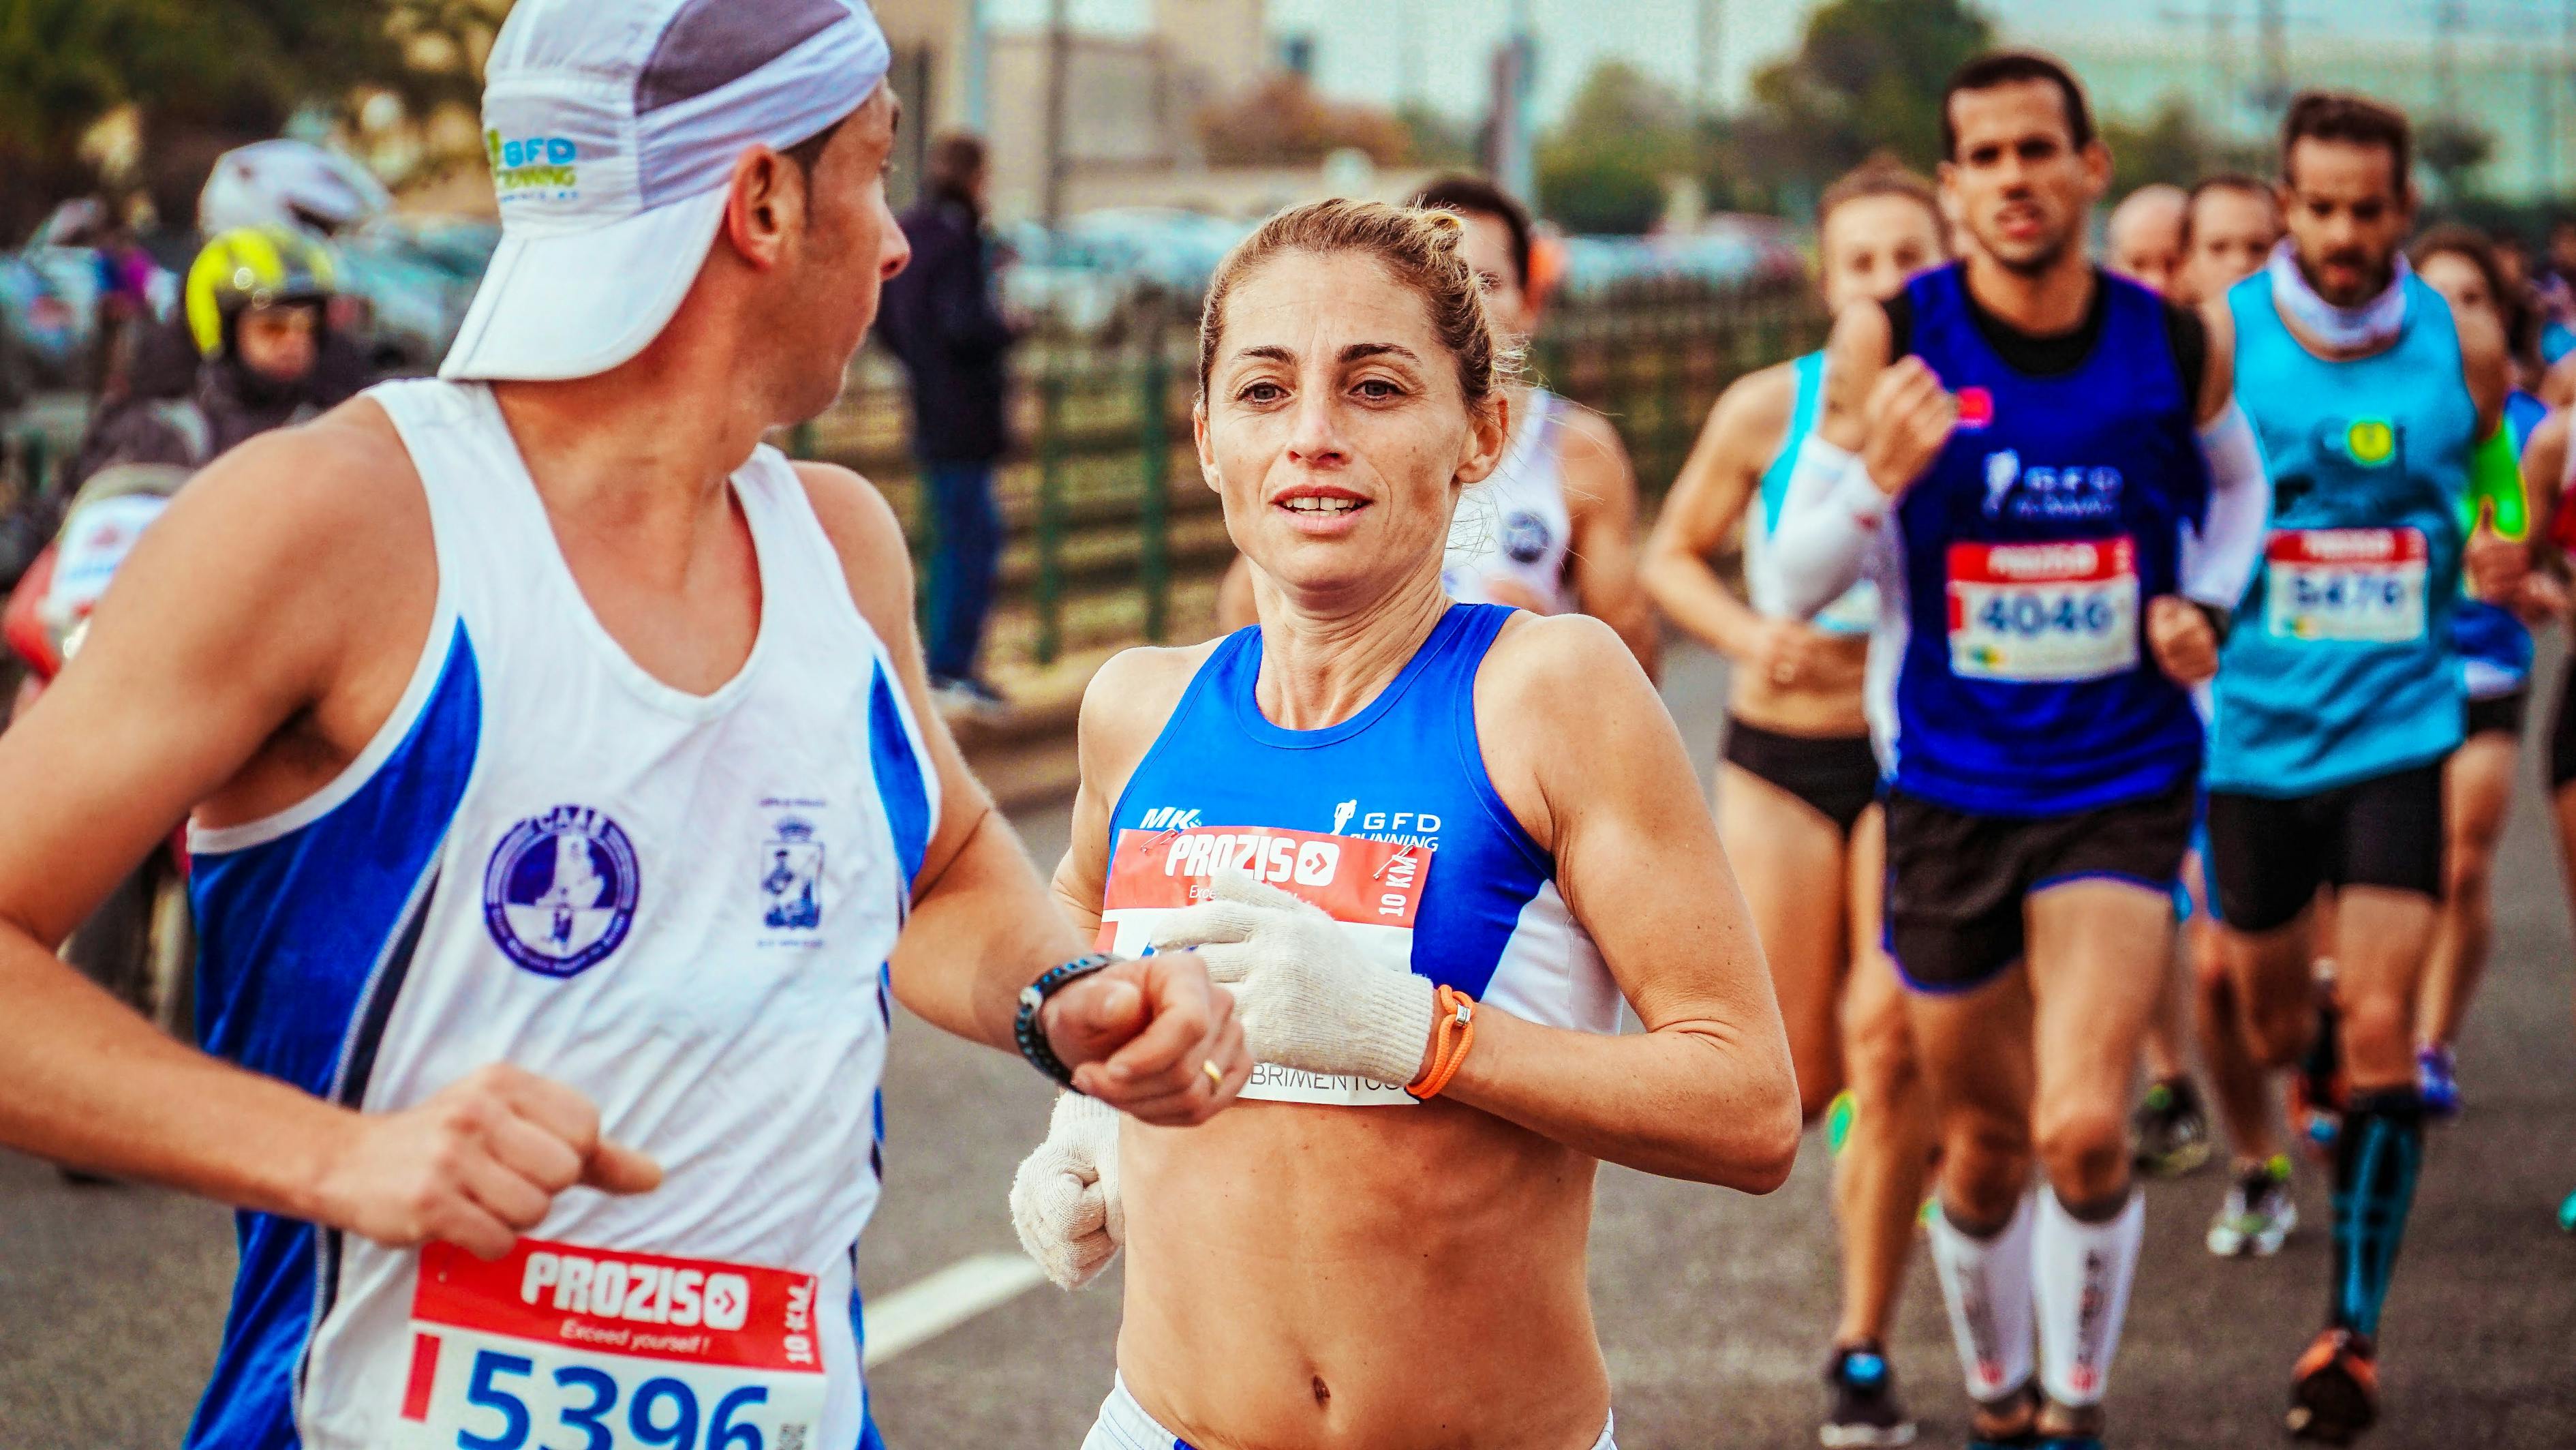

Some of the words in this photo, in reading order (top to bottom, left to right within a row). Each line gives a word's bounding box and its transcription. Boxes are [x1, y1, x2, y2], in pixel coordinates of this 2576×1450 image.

[1363, 812, 1441, 832] GFD
[1385, 854, 1418, 889] KM
[1378, 893, 1407, 917] 10
[520, 1252, 705, 1328] PROZIS
[559, 1318, 630, 1348] Exceed
[784, 1334, 814, 1364] 10
[457, 1349, 769, 1450] 5396
